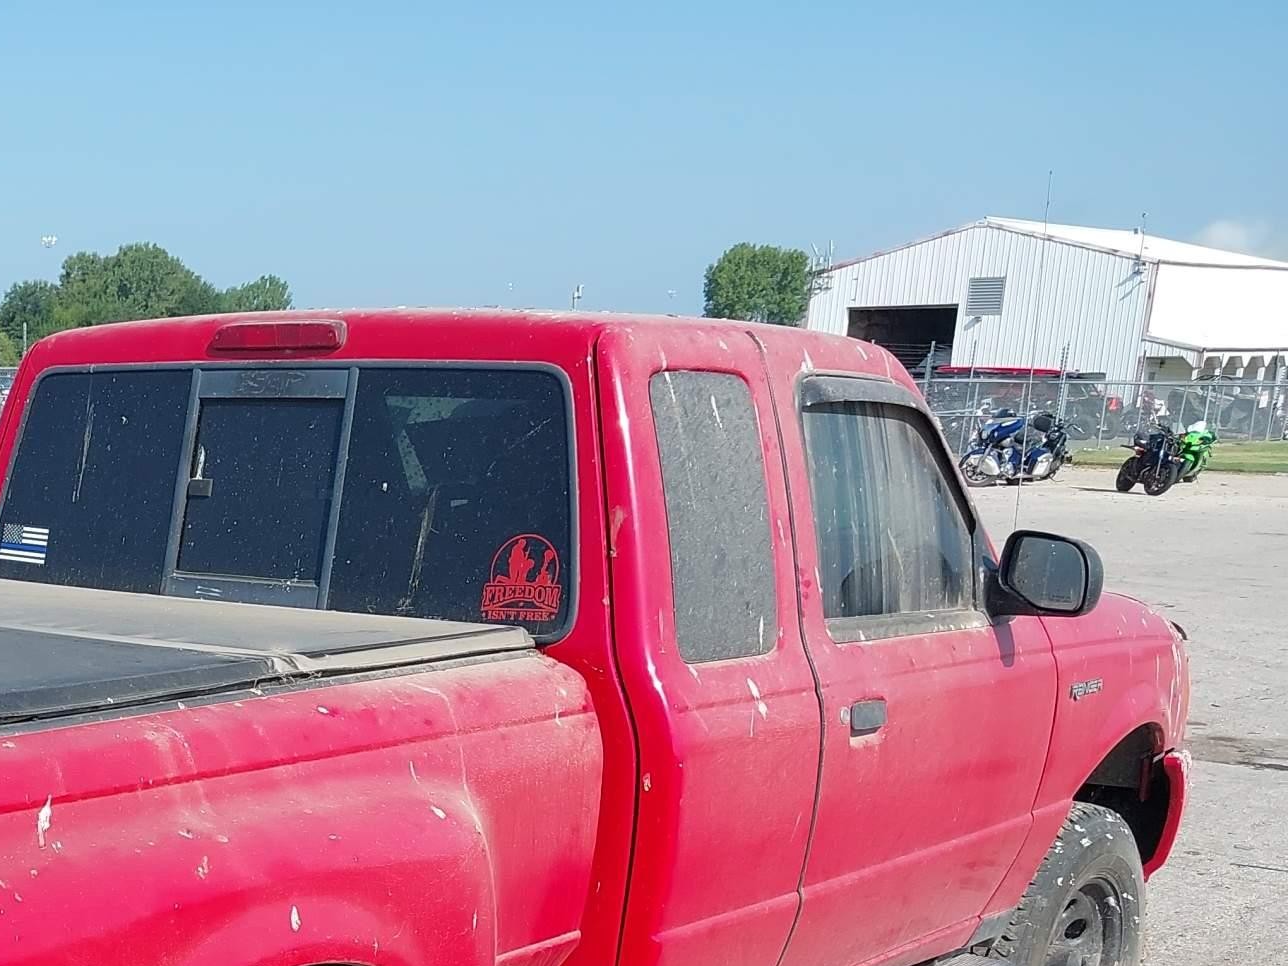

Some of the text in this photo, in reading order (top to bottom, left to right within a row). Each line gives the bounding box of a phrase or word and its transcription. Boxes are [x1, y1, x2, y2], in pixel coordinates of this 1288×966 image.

[484, 586, 559, 608] FREEDOM
[487, 610, 550, 621] ISN'T FREE
